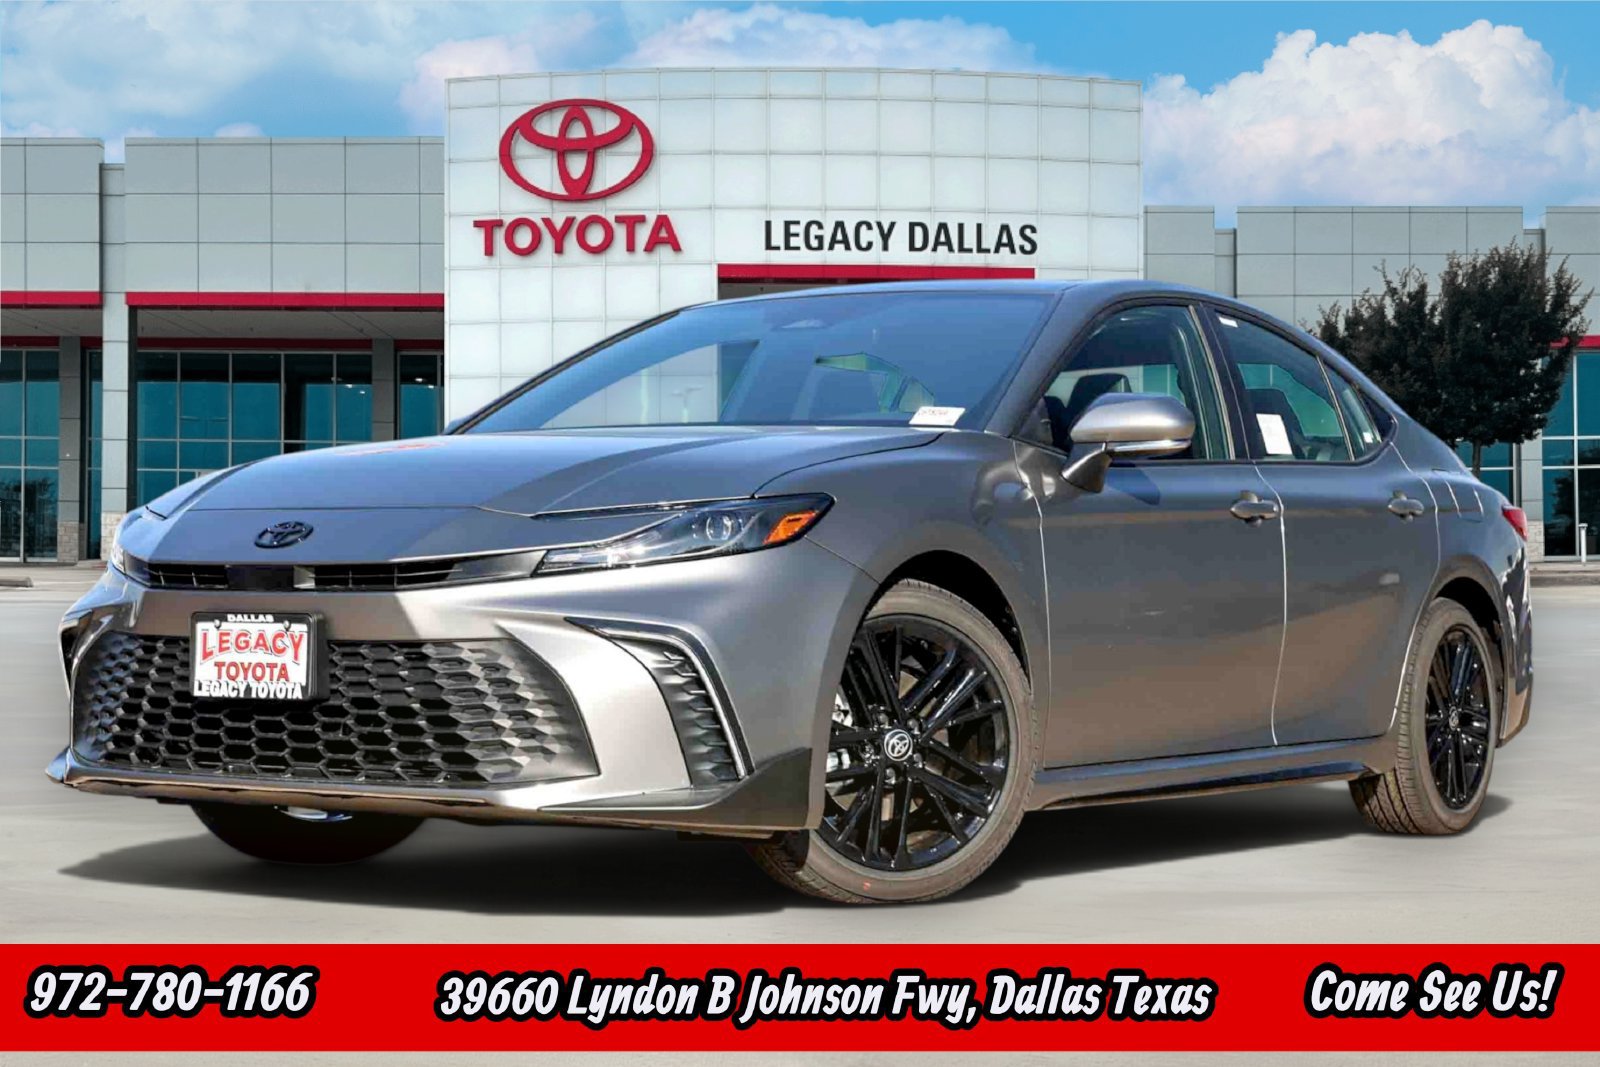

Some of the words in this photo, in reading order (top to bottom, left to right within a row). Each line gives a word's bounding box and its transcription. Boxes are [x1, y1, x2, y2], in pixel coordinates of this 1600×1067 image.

[473, 213, 682, 257] TOYOTA
[764, 219, 896, 253] LEGACY
[908, 221, 1039, 256] DALLAS
[226, 613, 274, 623] DALLAS
[200, 629, 305, 663] LEGACY
[213, 661, 290, 682] TOYOTA
[193, 681, 249, 698] LEGACY
[250, 682, 303, 700] TOYOTA
